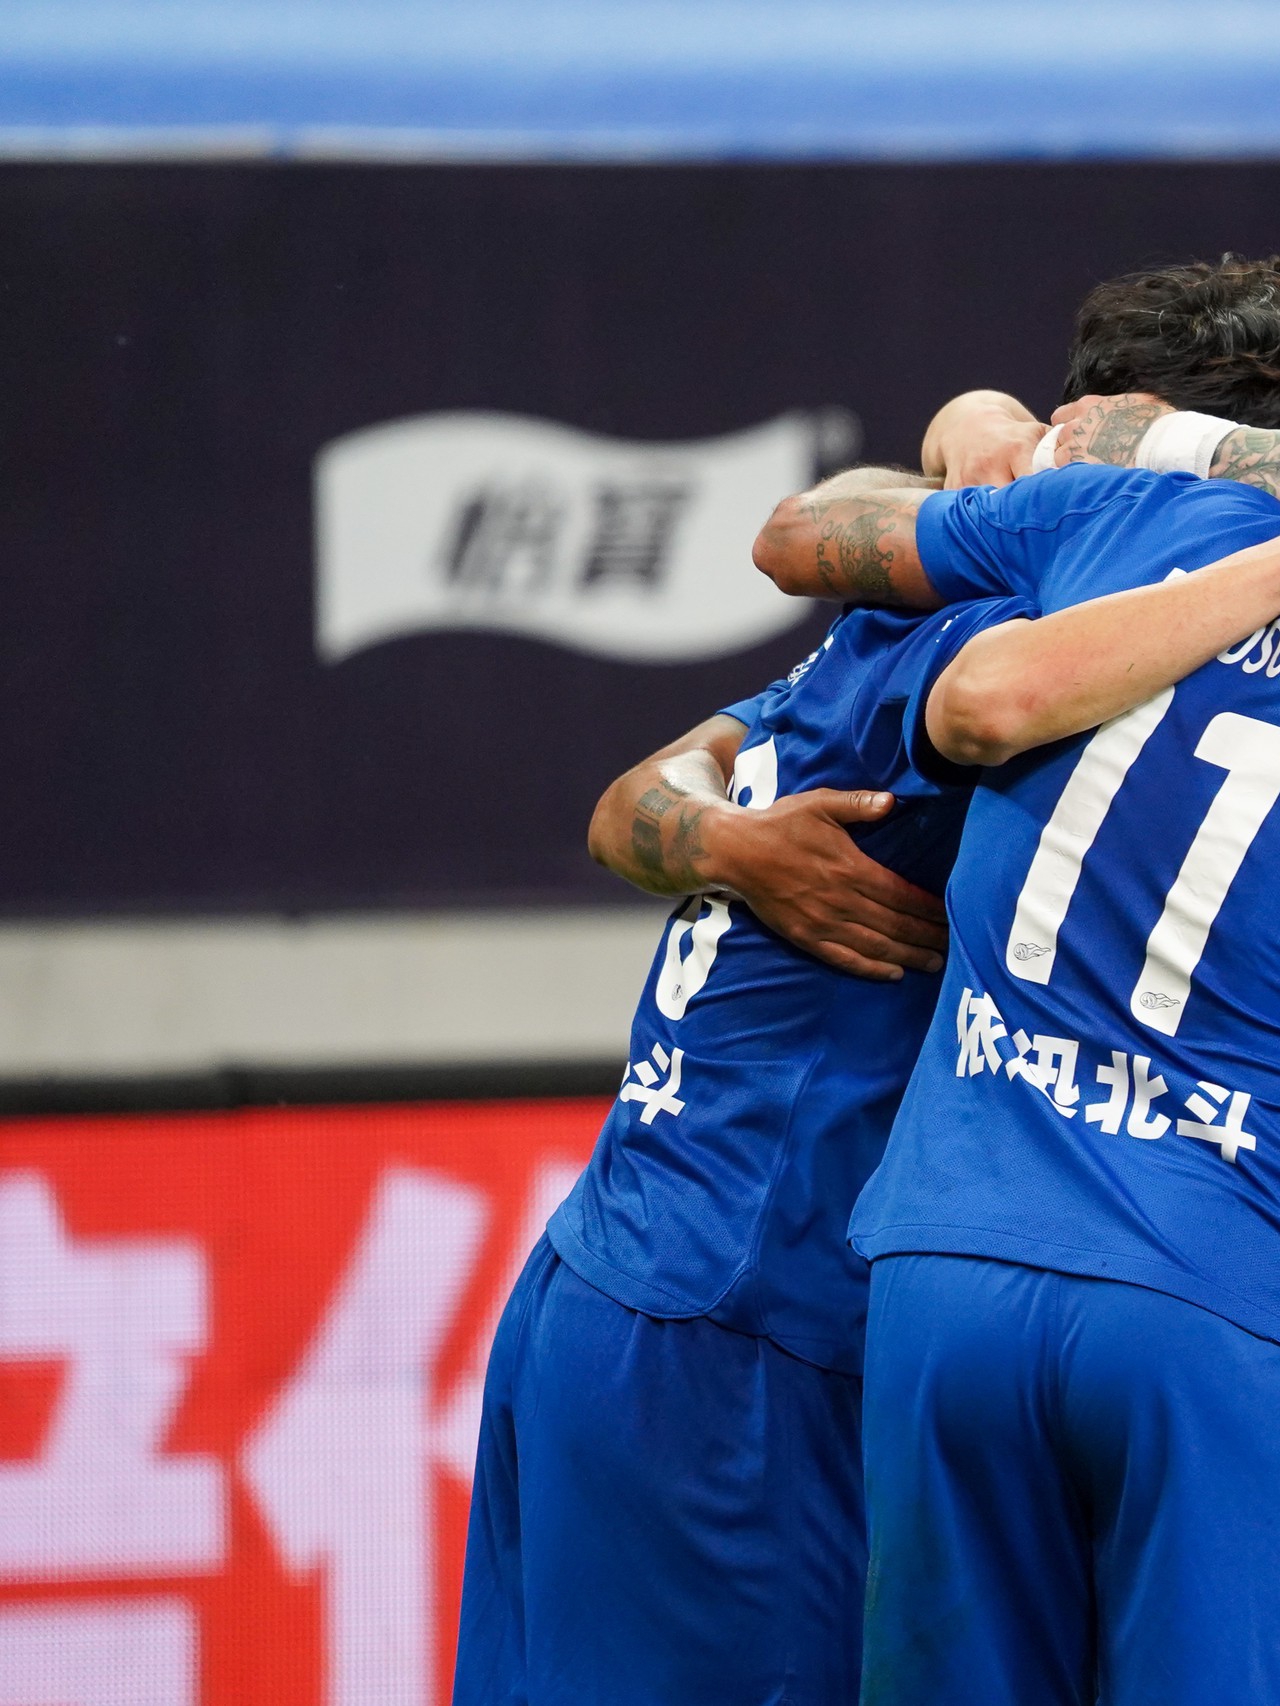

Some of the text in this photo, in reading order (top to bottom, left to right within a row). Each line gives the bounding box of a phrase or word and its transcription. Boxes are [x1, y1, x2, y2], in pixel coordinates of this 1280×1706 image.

[619, 1041, 687, 1126] 斗
[956, 987, 1257, 1164] 依迅北斗
